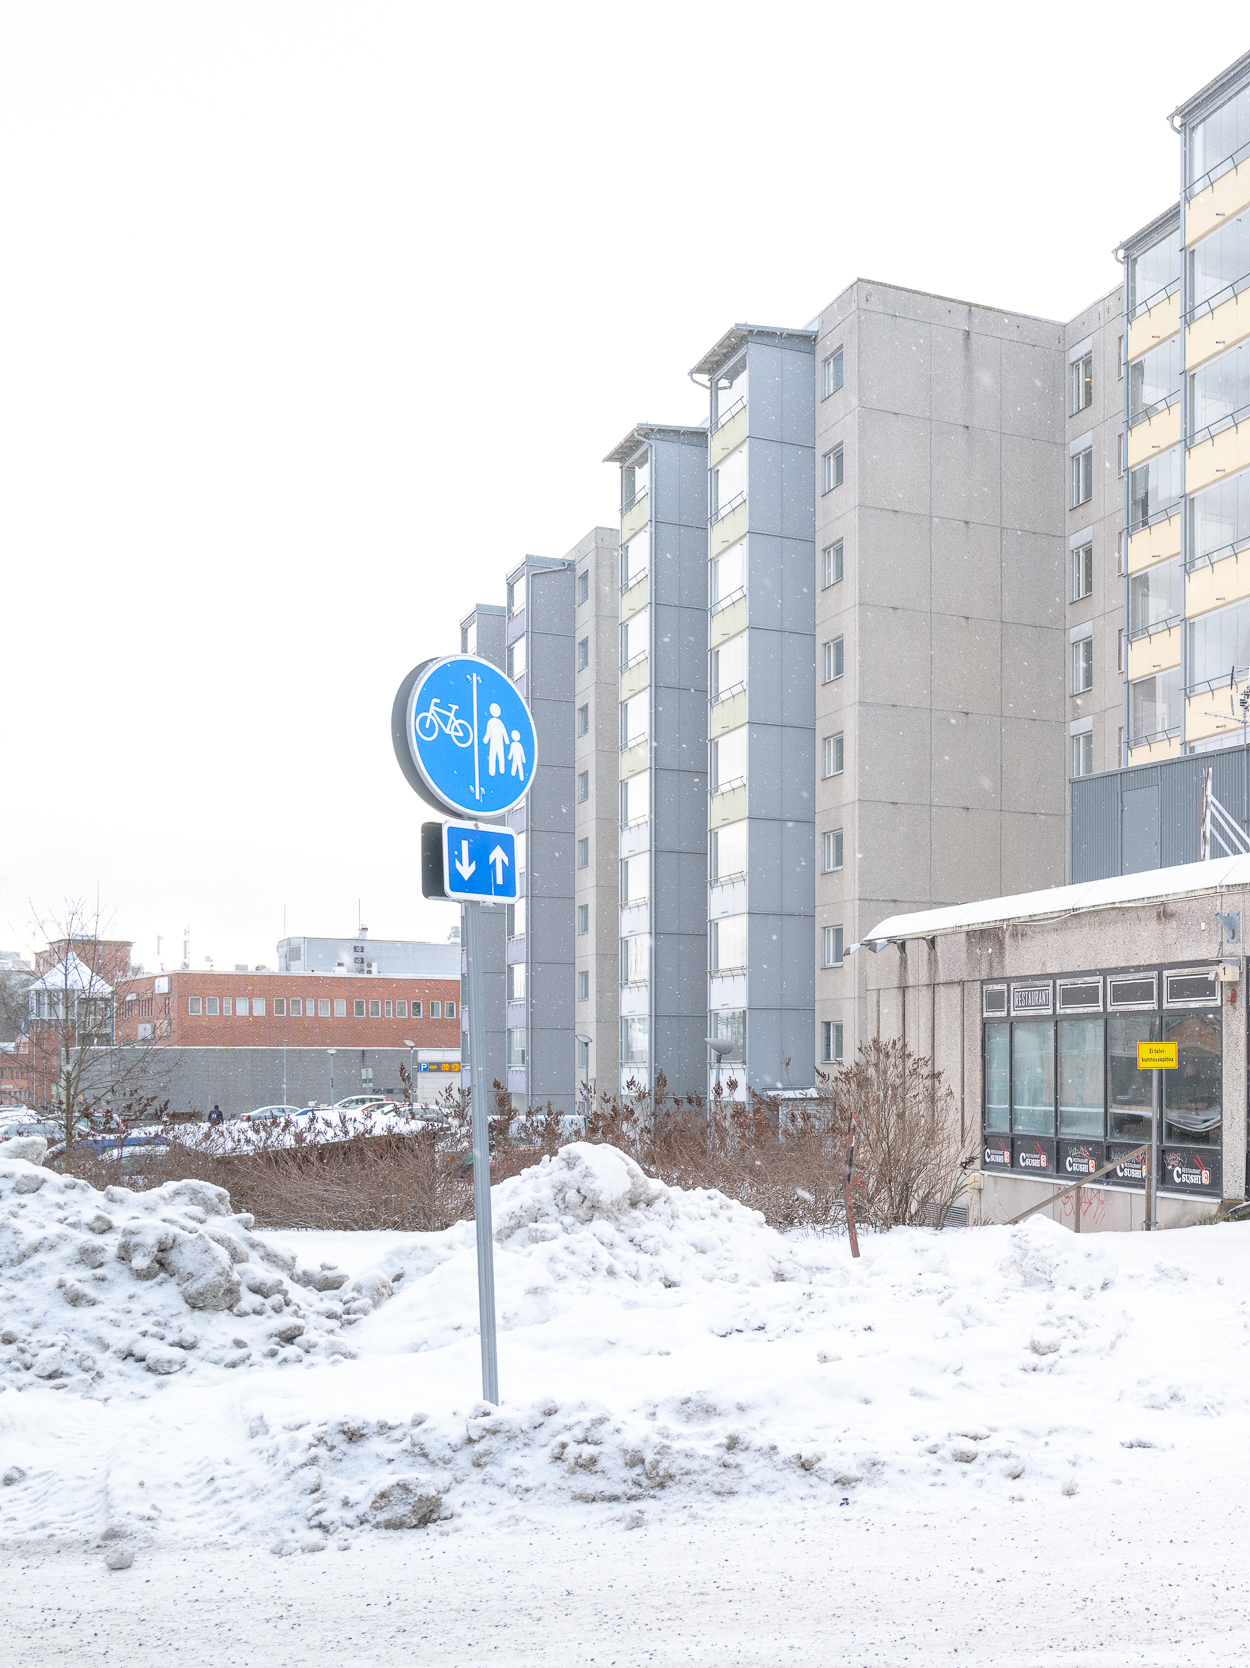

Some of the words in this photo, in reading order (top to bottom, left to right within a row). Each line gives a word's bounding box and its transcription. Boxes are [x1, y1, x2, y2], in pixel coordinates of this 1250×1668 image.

[1222, 966, 1226, 976] 1
[1015, 990, 1050, 1006] RESTAURANT
[421, 1063, 428, 1071] P
[990, 1154, 1004, 1163] SUSHI
[1026, 1158, 1040, 1167] SUSHI
[1073, 1163, 1089, 1173] SUSHI
[1124, 1169, 1142, 1178] SUSHI
[1182, 1174, 1201, 1184] SUSHI
